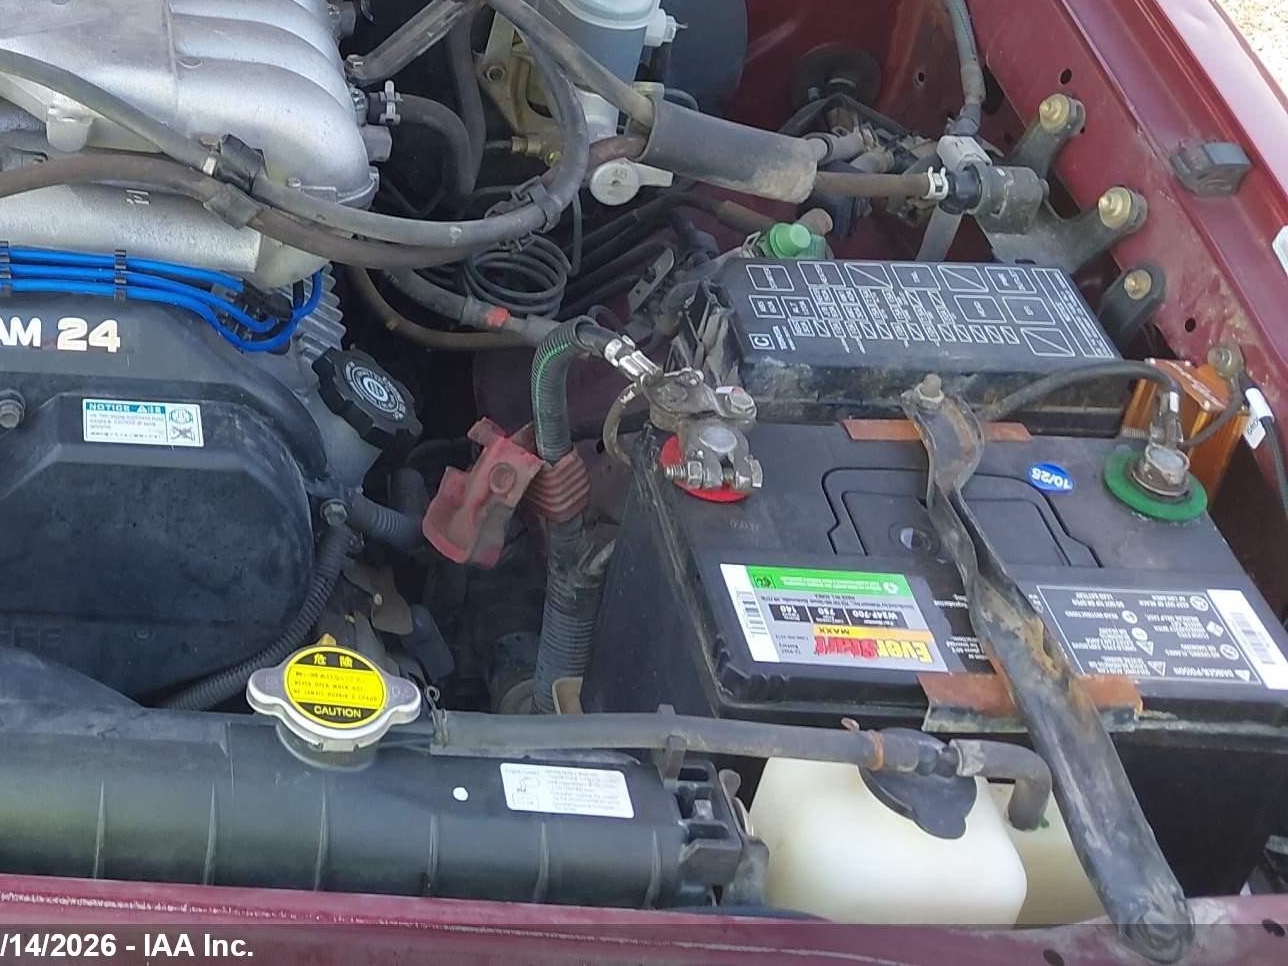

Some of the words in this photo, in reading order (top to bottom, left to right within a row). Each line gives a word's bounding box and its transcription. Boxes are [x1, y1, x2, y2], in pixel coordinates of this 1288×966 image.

[56, 317, 122, 353] 24
[753, 336, 770, 346] C
[1031, 467, 1073, 490] 10/25
[818, 626, 850, 635] MAXX
[811, 635, 932, 663] EverStart
[314, 705, 362, 718] CAUTION
